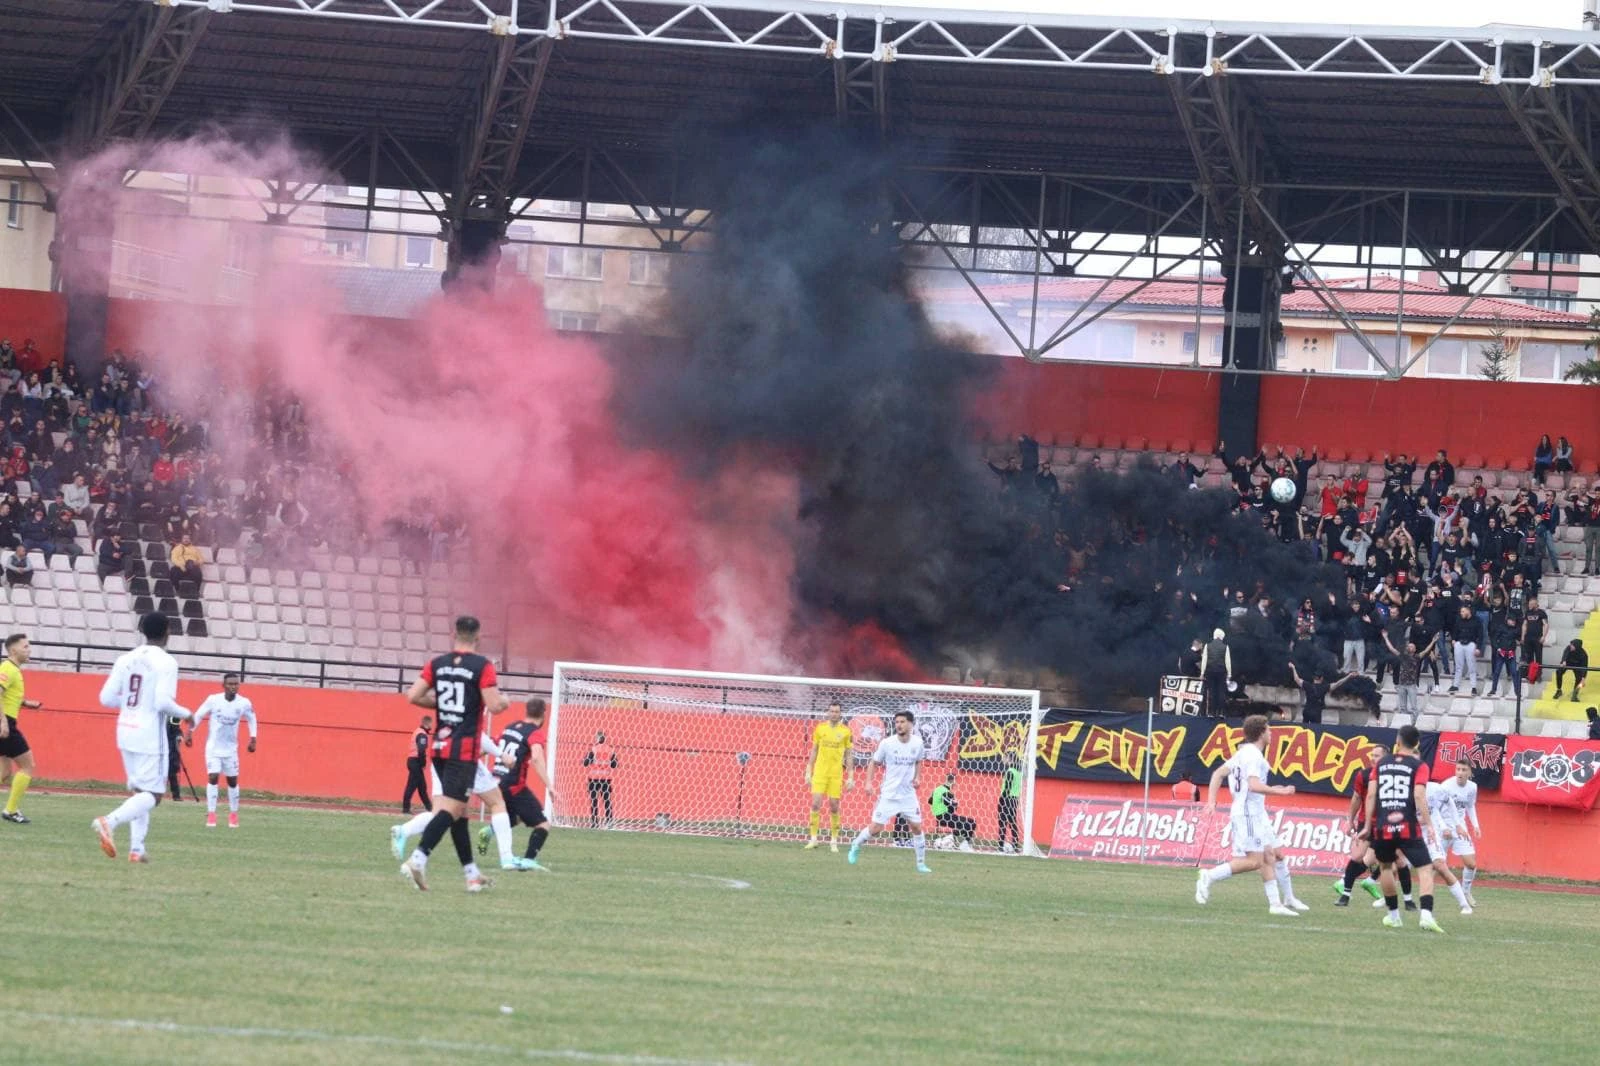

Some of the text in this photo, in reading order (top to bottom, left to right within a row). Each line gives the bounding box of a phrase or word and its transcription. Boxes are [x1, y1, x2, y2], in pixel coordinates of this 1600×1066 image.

[127, 673, 142, 707] 9
[437, 680, 465, 712] 21
[1078, 723, 1186, 780] CITY
[1199, 723, 1377, 792] ATACK
[1379, 774, 1411, 799] 25
[1069, 800, 1199, 845] tuzlanski
[1220, 808, 1357, 854] tlanski
[1092, 838, 1161, 857] pilsner
